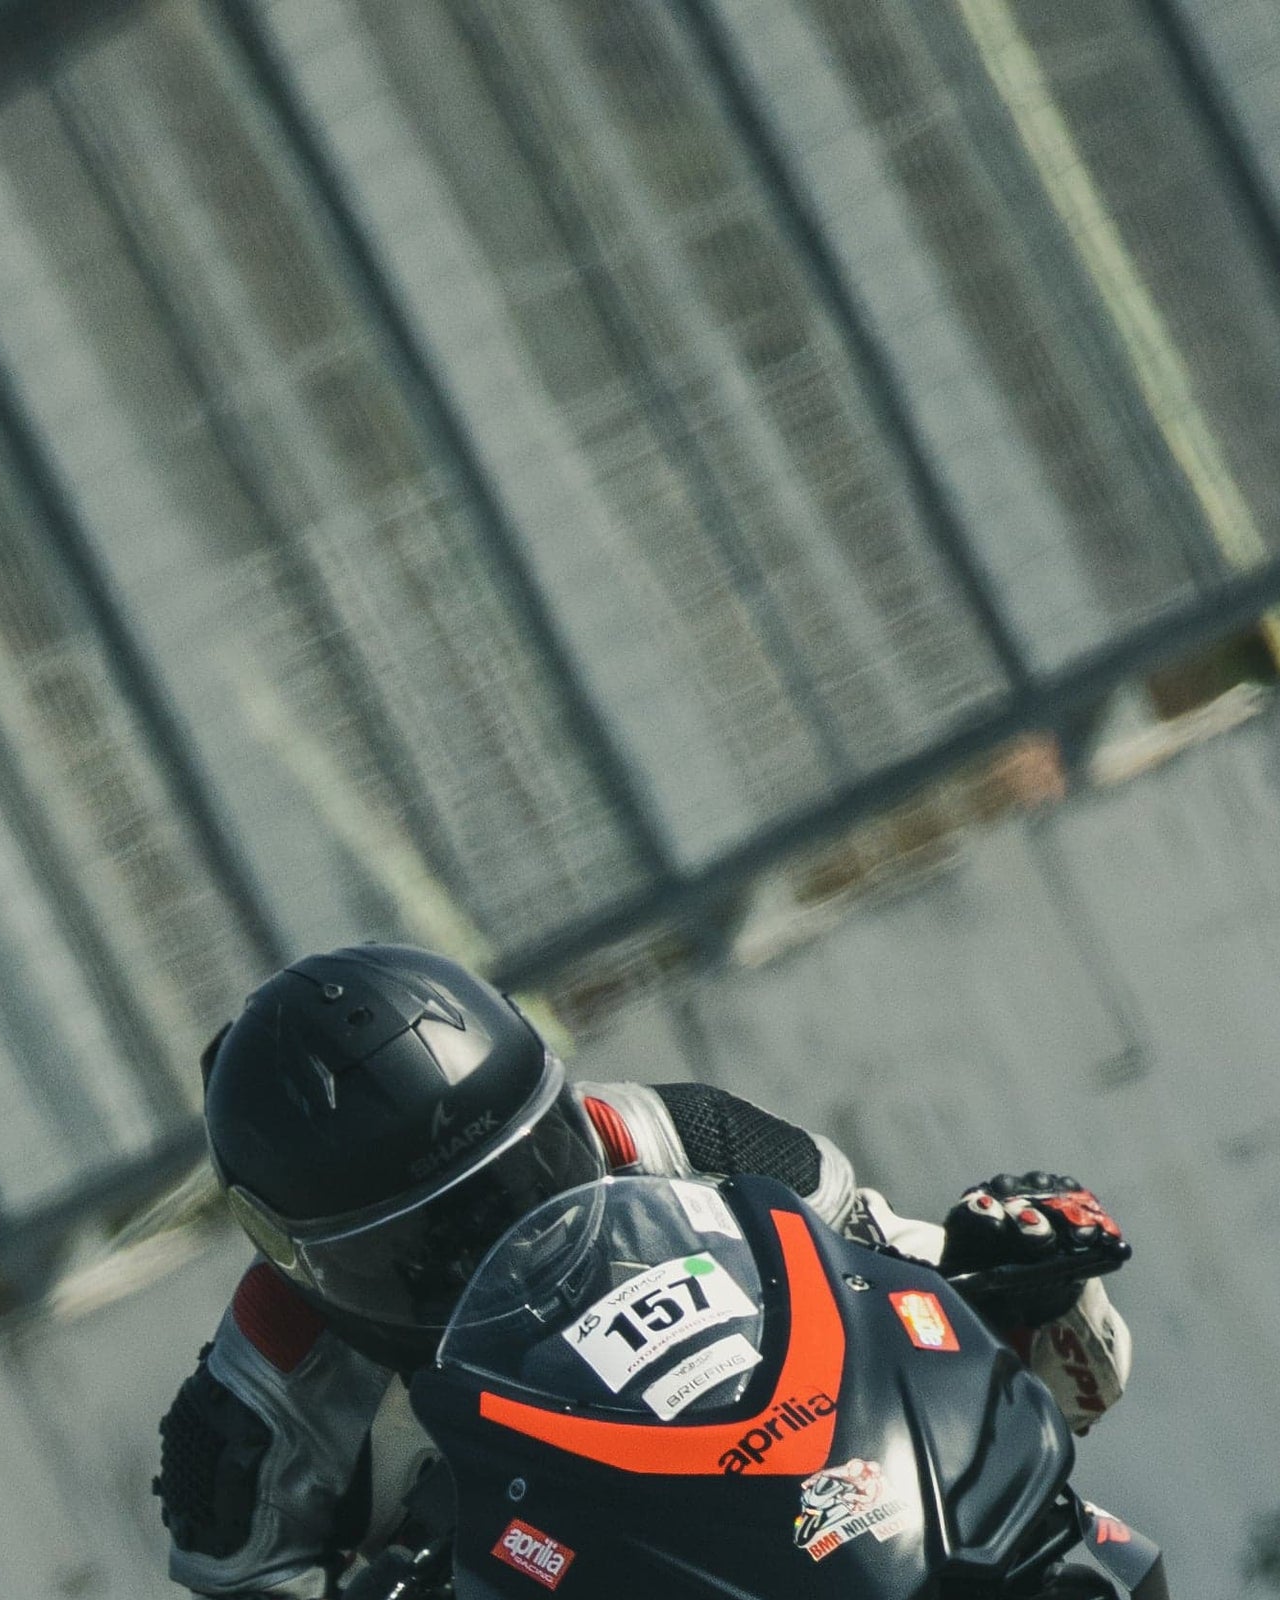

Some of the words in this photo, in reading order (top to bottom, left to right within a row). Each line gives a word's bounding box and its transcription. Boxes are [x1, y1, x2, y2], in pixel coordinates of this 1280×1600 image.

[408, 1109, 500, 1176] SHARK
[604, 1275, 710, 1352] 157
[666, 1354, 746, 1408] BRIEFING
[718, 1392, 839, 1478] aprilia
[503, 1528, 565, 1576] aprilia
[809, 1531, 842, 1559] BMR
